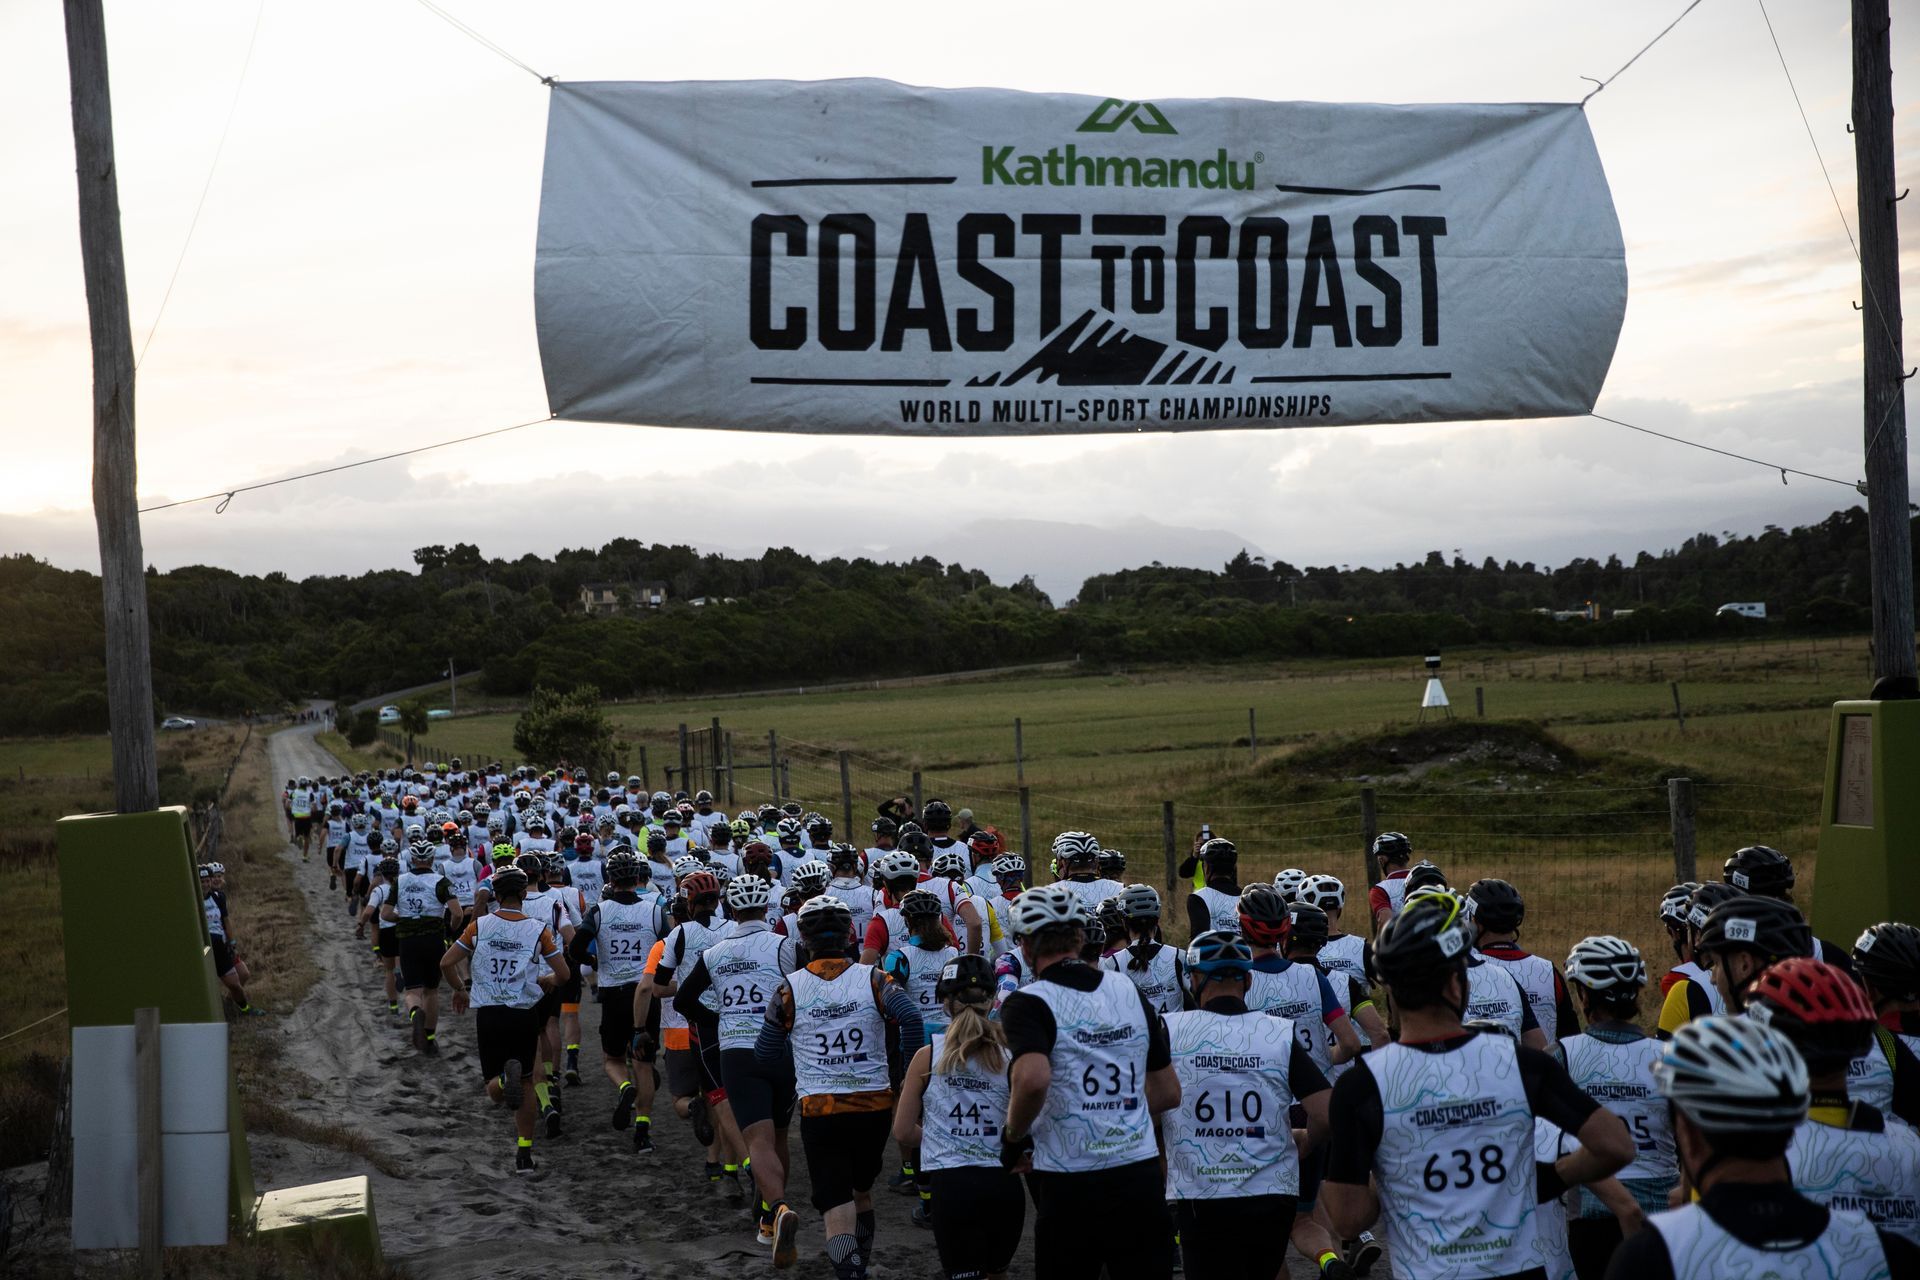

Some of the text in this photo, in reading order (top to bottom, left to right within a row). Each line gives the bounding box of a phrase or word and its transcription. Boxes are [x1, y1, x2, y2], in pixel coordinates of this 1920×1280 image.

[982, 144, 1256, 191] Kathmandu
[749, 212, 1448, 352] COAST TO COAST
[900, 395, 1332, 424] WORLD MULTI-SPORT CHAMPIONSHIPS
[1729, 926, 1749, 938] 398
[610, 939, 642, 955] 524
[490, 957, 518, 976] 375
[722, 983, 763, 1007] 626
[815, 1028, 864, 1056] 349
[817, 1055, 852, 1065] TRENT
[1195, 1056, 1224, 1068] COAST
[1232, 1056, 1261, 1069] COAST
[1082, 1062, 1136, 1096] 631
[1082, 1101, 1122, 1111] HARVEY
[1195, 1090, 1262, 1123] 610
[1416, 1107, 1450, 1127] COAST
[1461, 1100, 1498, 1121] COAST
[951, 1128, 980, 1136] ELLA
[1195, 1127, 1244, 1138] MAGOO
[1423, 1144, 1507, 1193] 638
[1429, 1235, 1513, 1257] Kathmandu
